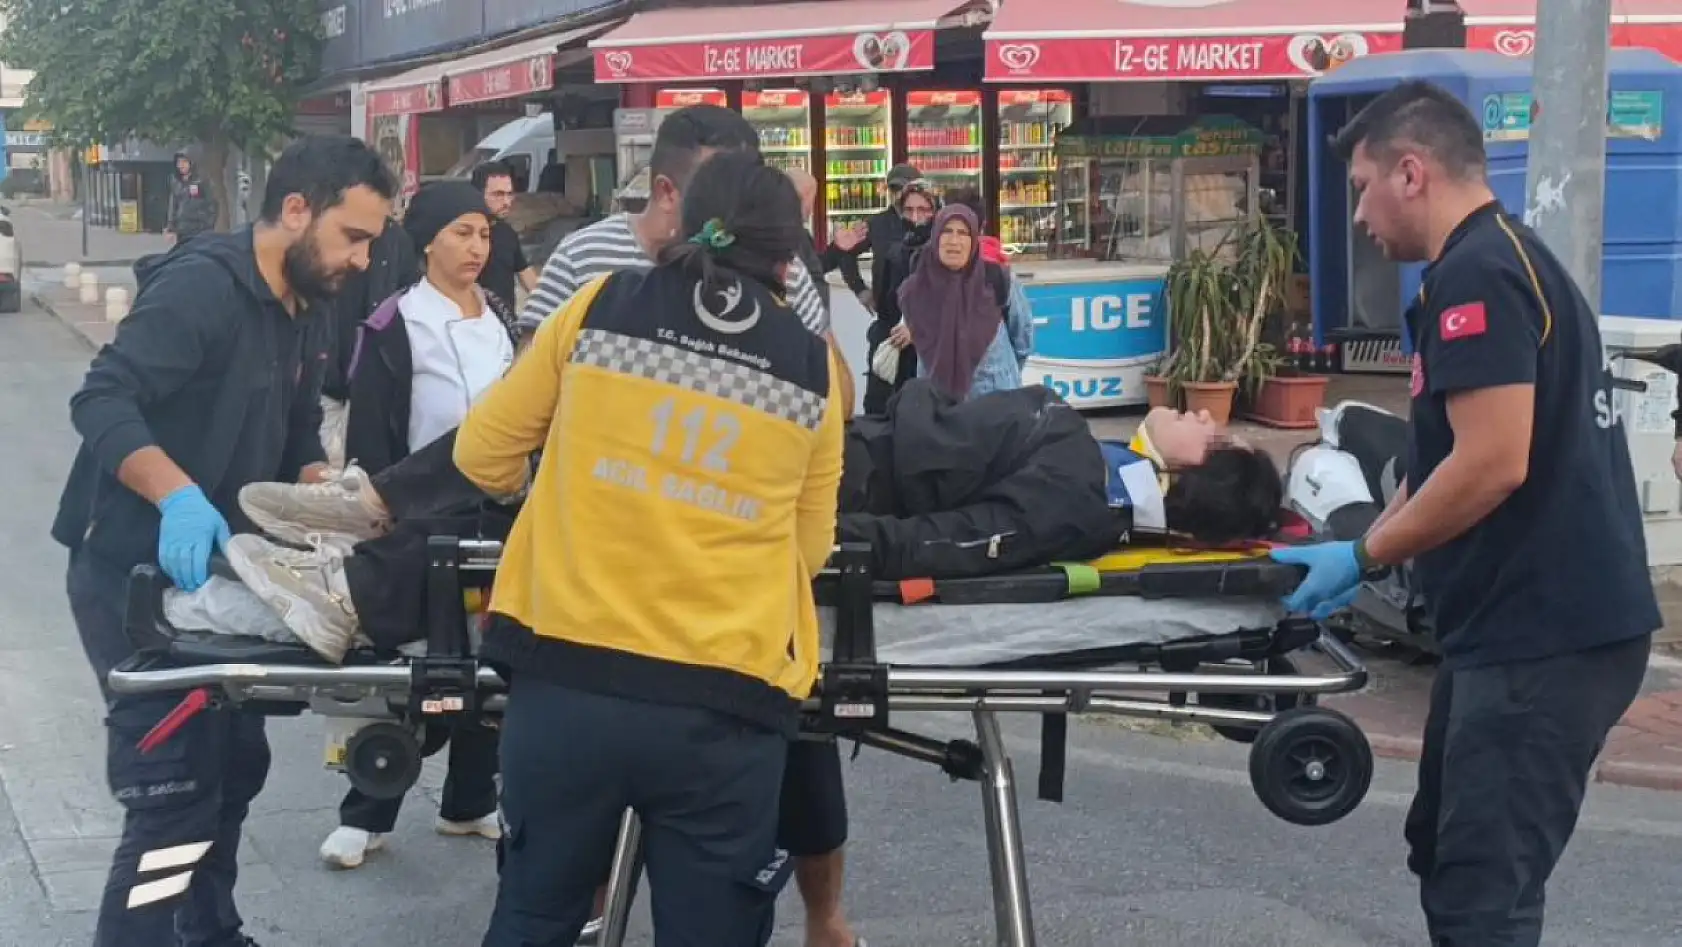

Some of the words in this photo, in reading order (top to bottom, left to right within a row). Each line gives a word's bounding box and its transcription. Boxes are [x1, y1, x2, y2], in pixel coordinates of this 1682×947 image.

[746, 44, 804, 71] MARKET
[1176, 42, 1264, 70] MARKET
[1071, 293, 1152, 332] ICE
[649, 393, 742, 474] 112
